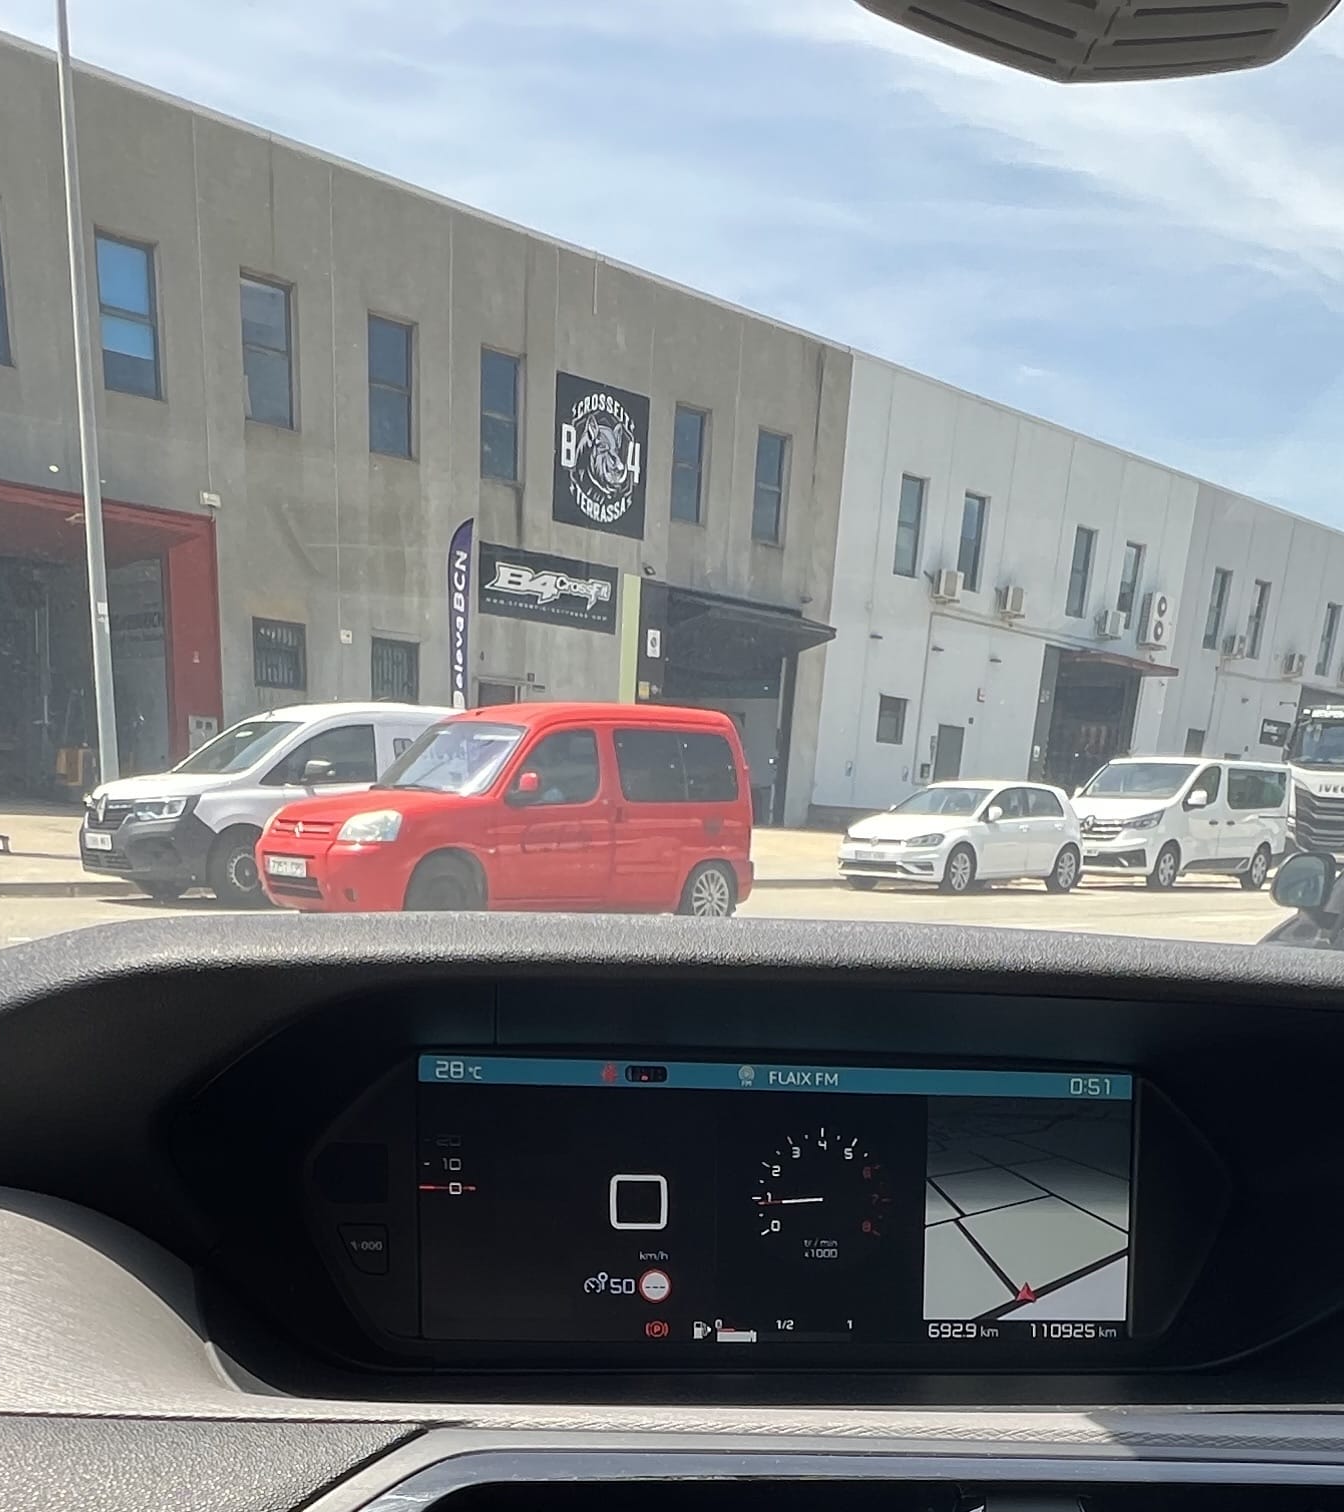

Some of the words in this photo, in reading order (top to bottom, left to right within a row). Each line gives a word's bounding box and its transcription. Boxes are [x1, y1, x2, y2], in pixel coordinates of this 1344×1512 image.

[577, 393, 630, 424] CROSSFIT
[627, 441, 641, 484] 4
[575, 483, 626, 523] TERRASSA
[436, 1061, 464, 1079] 28
[769, 1071, 812, 1086] FLAIX
[815, 1072, 839, 1087] FM
[1070, 1078, 1112, 1096] 0:51
[791, 1146, 801, 1159] 3
[817, 1140, 827, 1151] 4
[843, 1147, 854, 1160] 5
[771, 1164, 781, 1177] 2
[770, 1219, 781, 1232] 0
[639, 1250, 669, 1261] km/h
[610, 1278, 636, 1295] 50
[775, 1319, 794, 1330] 1/2
[846, 1319, 853, 1330] 1
[928, 1322, 977, 1338] 692.9
[980, 1325, 999, 1338] km
[1030, 1322, 1096, 1338] 110925
[1098, 1325, 1117, 1338] km
